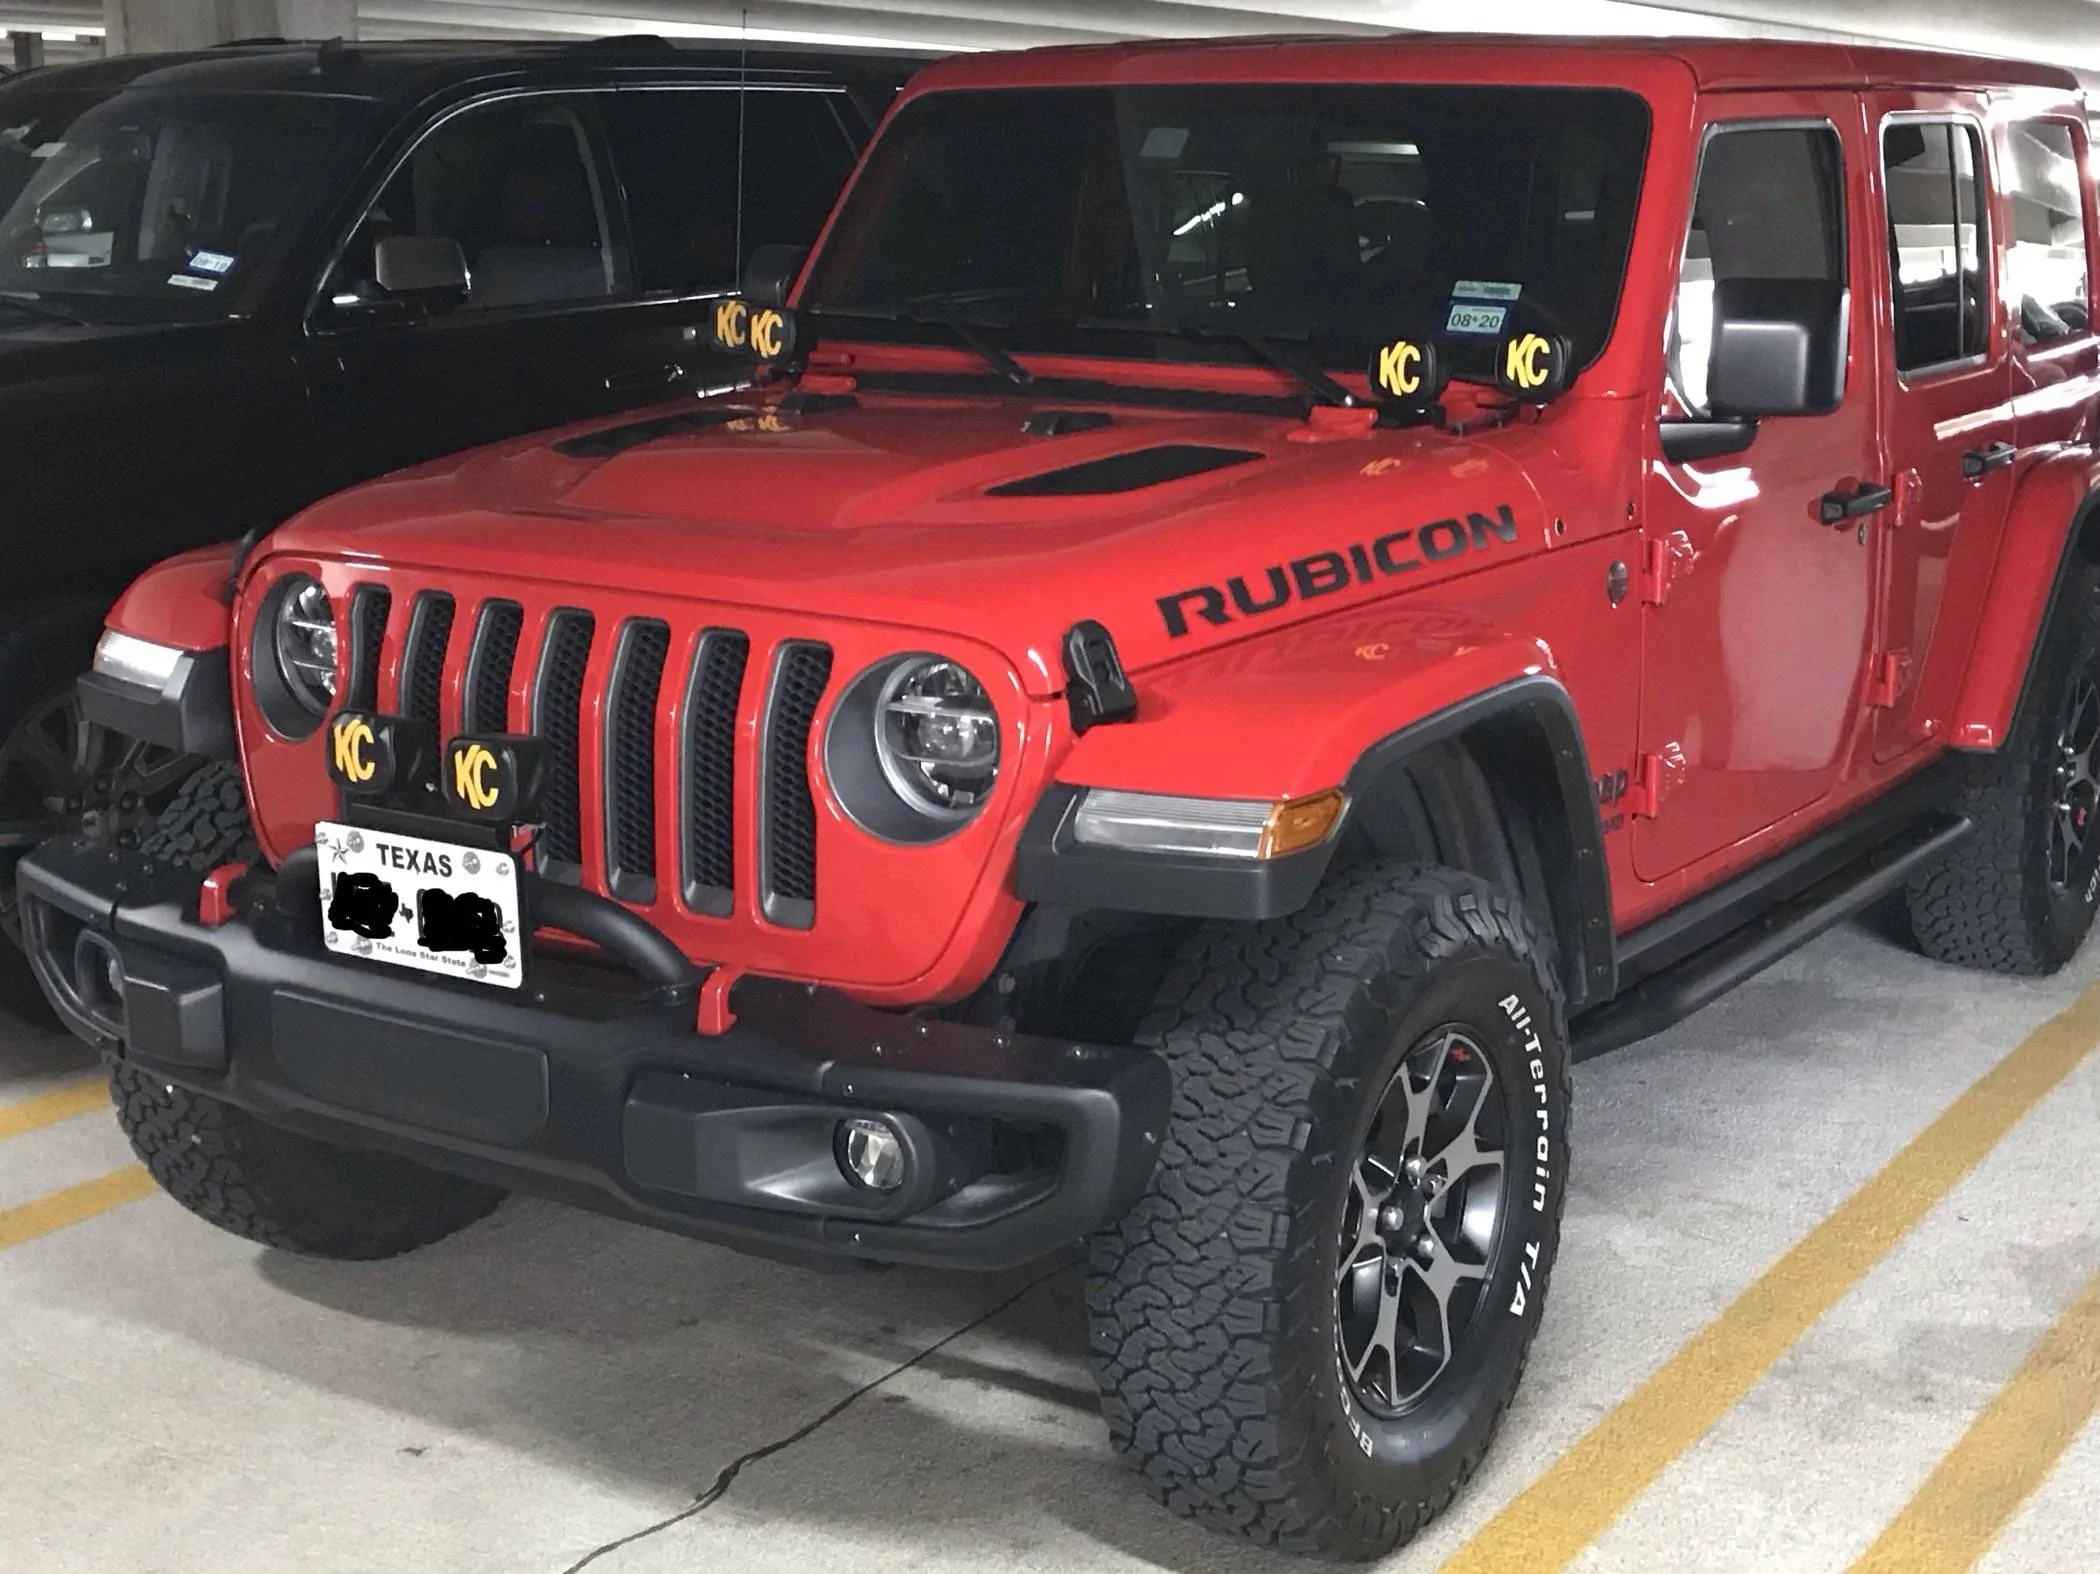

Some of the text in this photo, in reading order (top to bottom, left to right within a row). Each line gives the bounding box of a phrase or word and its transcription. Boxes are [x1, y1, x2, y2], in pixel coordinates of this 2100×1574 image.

[717, 300, 747, 347] KC
[751, 310, 783, 358] KC
[1380, 341, 1421, 396] KC
[1506, 333, 1550, 388] KC
[1155, 504, 1518, 638] RUBICON
[334, 719, 375, 782] KC
[455, 744, 499, 810] KC
[376, 843, 453, 877] TEXAS
[376, 942, 466, 967] The Lone Star State
[1498, 994, 1550, 1316] All-Terrain T/A
